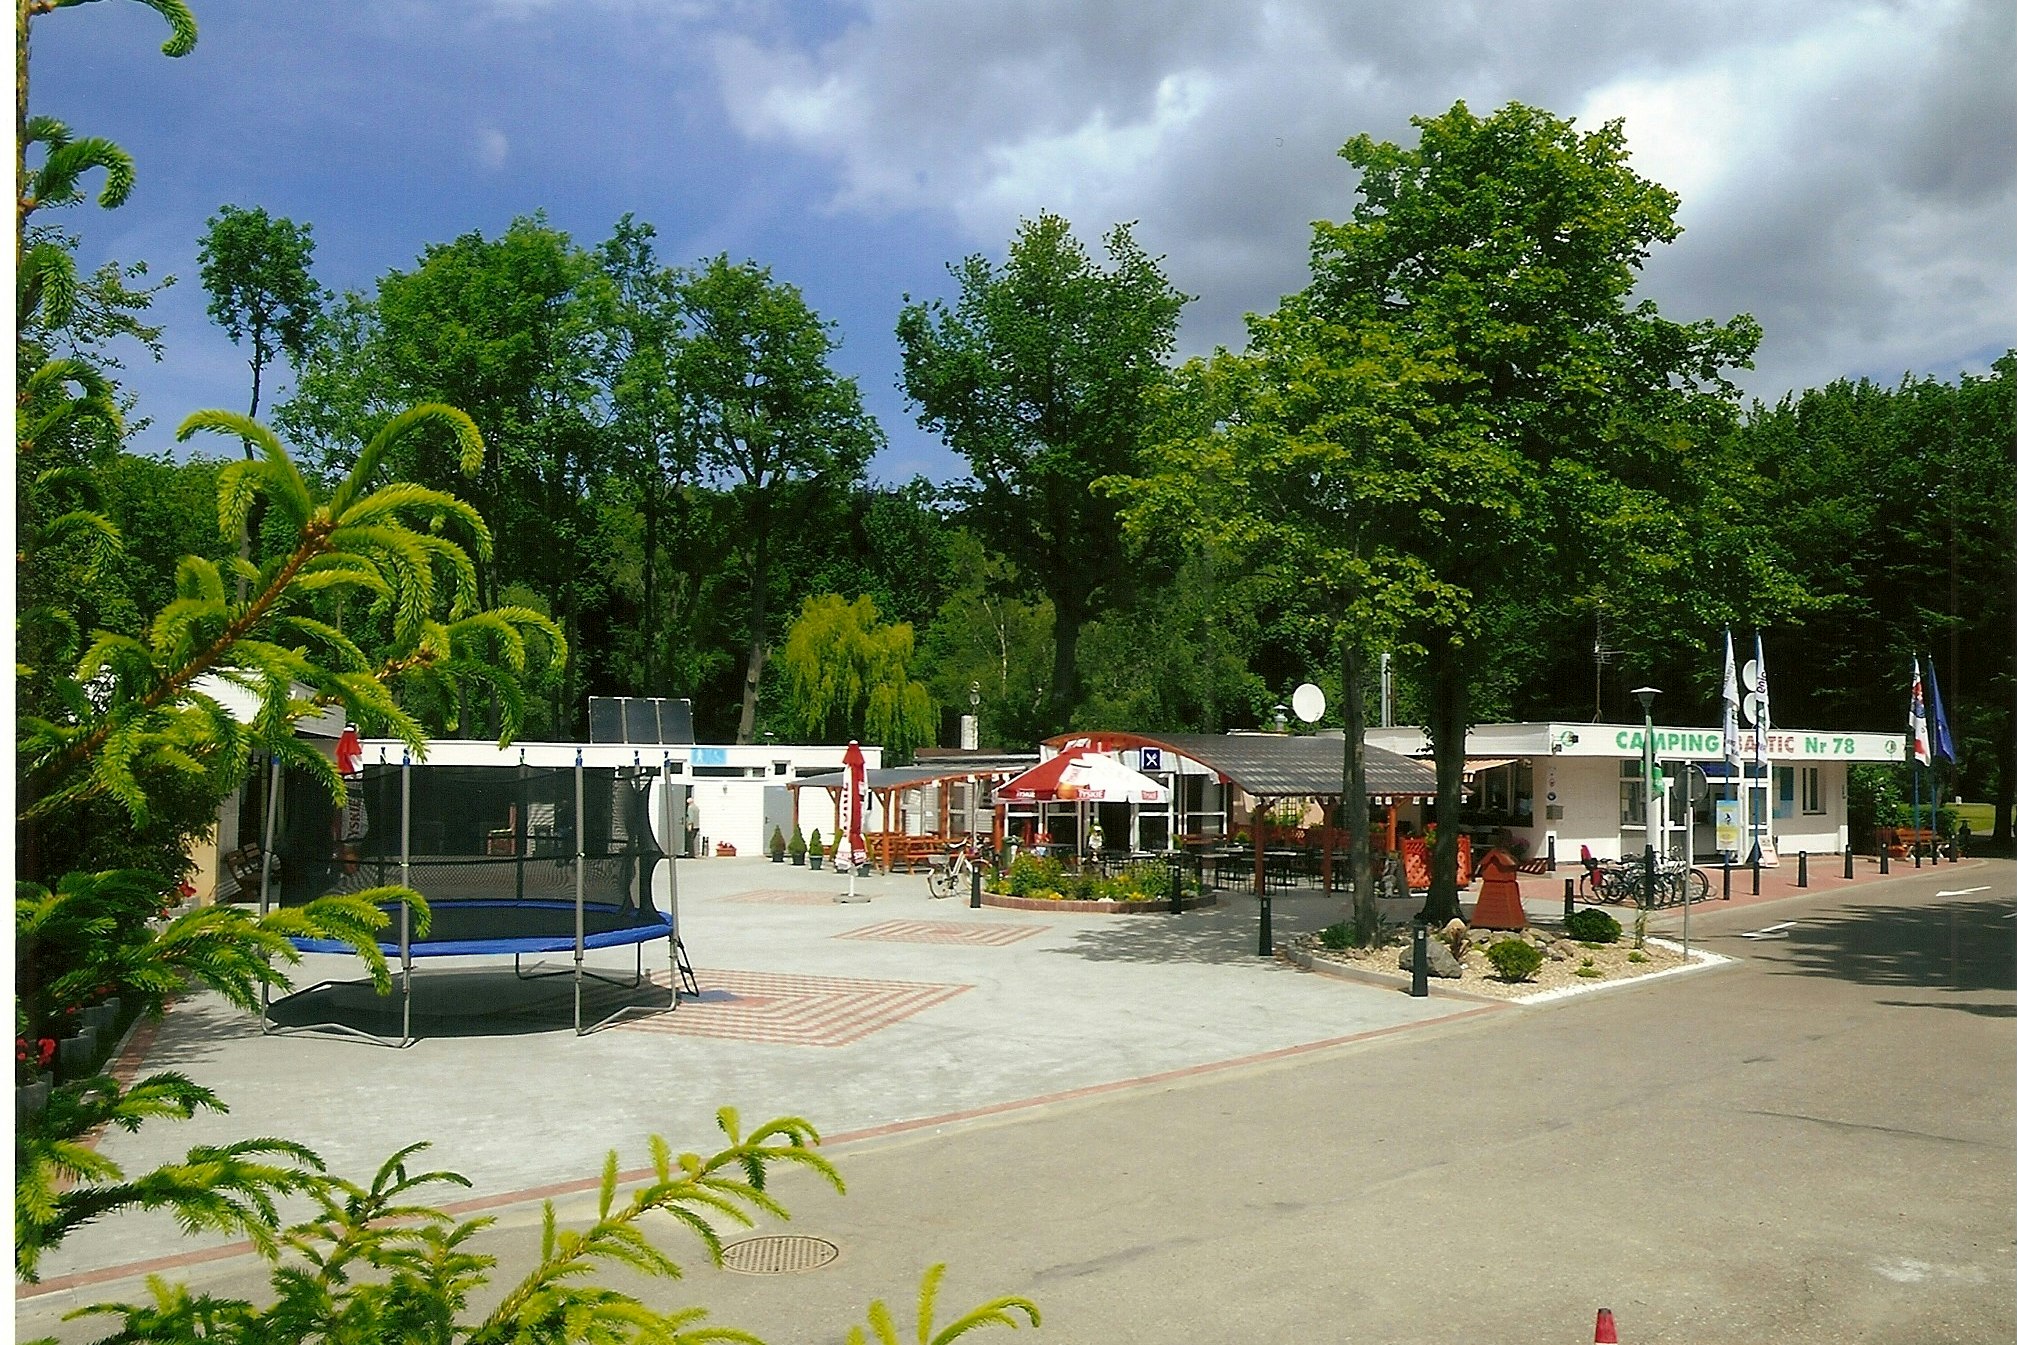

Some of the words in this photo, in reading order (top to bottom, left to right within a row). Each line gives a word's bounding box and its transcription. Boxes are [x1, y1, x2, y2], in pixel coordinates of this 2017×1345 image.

[1615, 731, 1720, 753] CAMPING
[1738, 734, 1795, 753] ATIC
[1805, 737, 1827, 754] Nr
[1832, 737, 1855, 754] 78
[1077, 789, 1105, 799] TYSKIE
[347, 799, 361, 838] YSKIE
